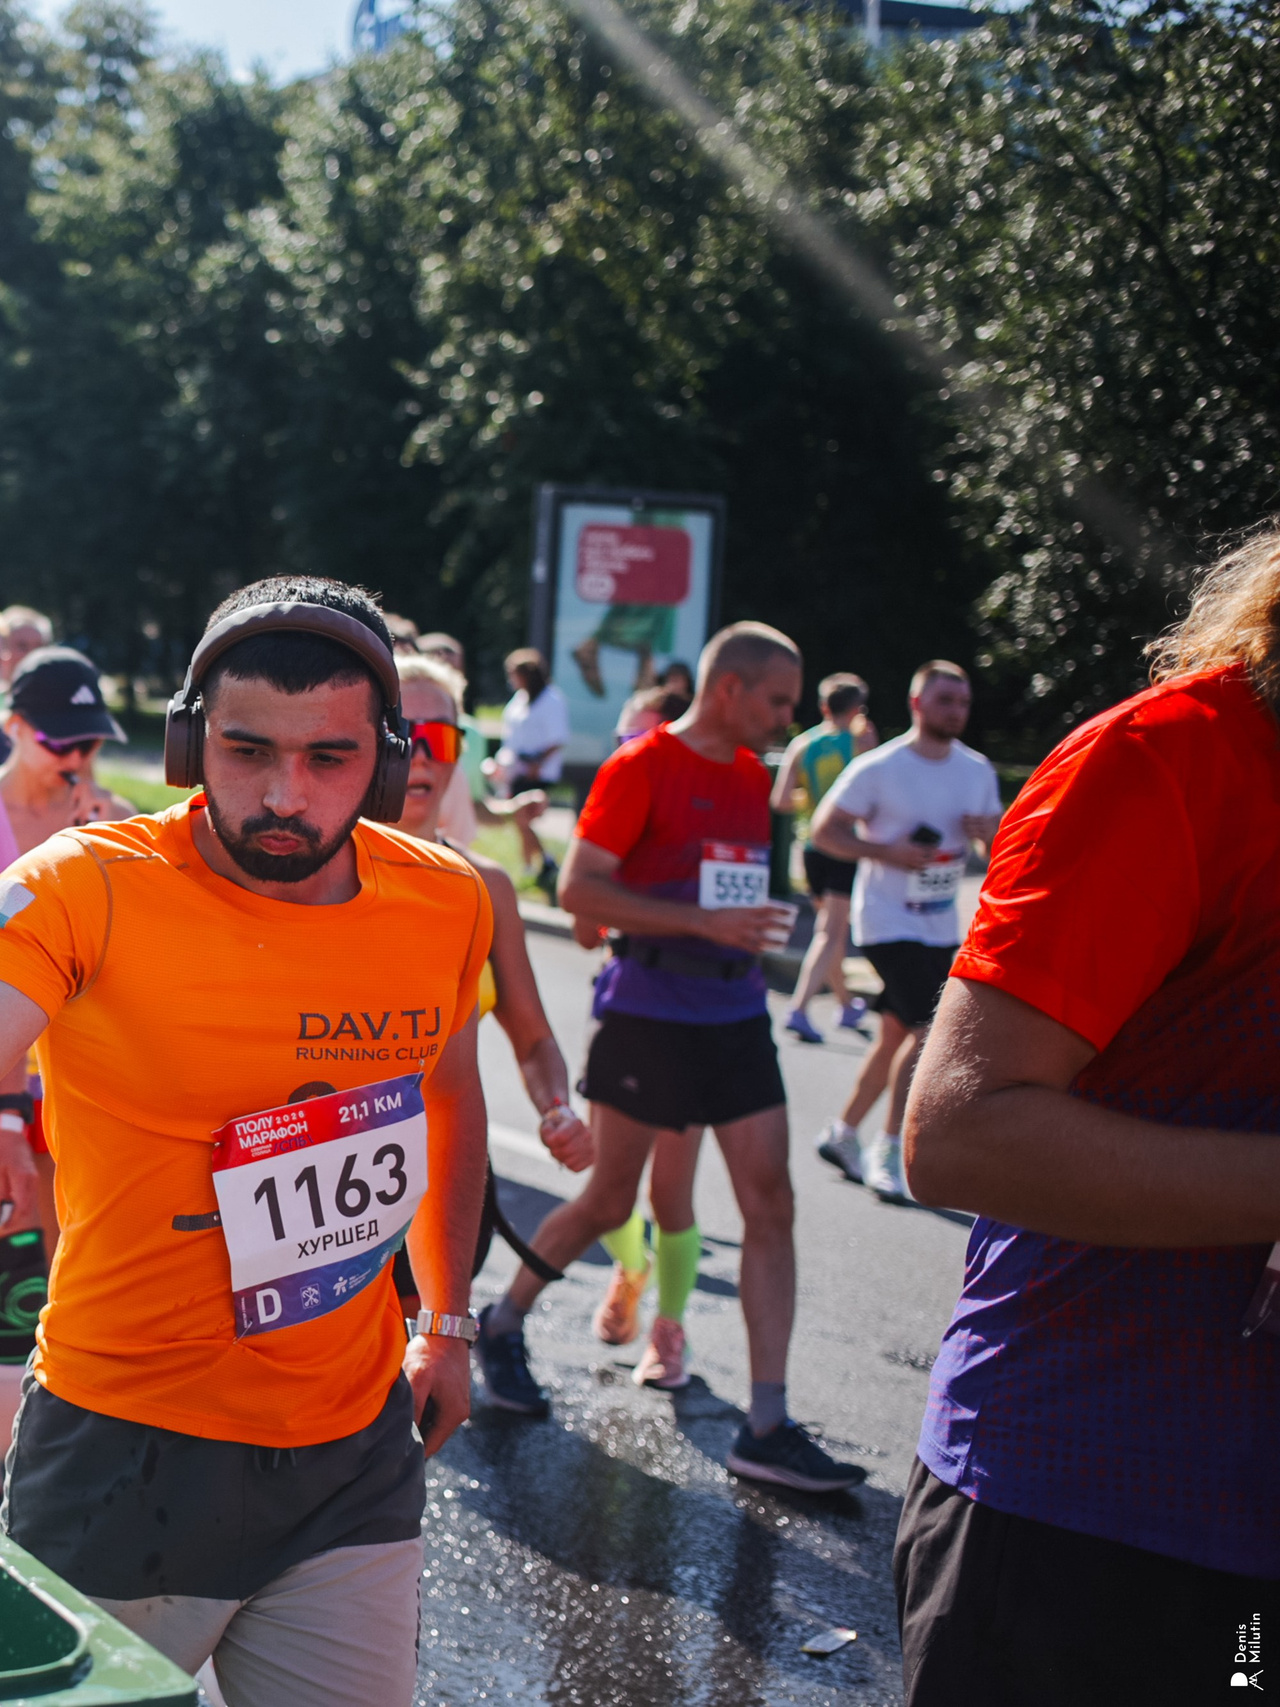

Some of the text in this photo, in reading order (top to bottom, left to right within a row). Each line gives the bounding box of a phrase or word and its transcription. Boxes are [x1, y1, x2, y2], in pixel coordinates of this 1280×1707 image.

[297, 1006, 441, 1040] DAV.TJ
[296, 1043, 439, 1061] RUNNING CLUB
[235, 1110, 305, 1137] ПОЛУ 2026
[338, 1101, 369, 1124] 21,1
[238, 1121, 309, 1150] МАРАФОН
[253, 1143, 408, 1241] 1163
[297, 1219, 379, 1259] ХУРШЕД
[255, 1287, 283, 1325] D
